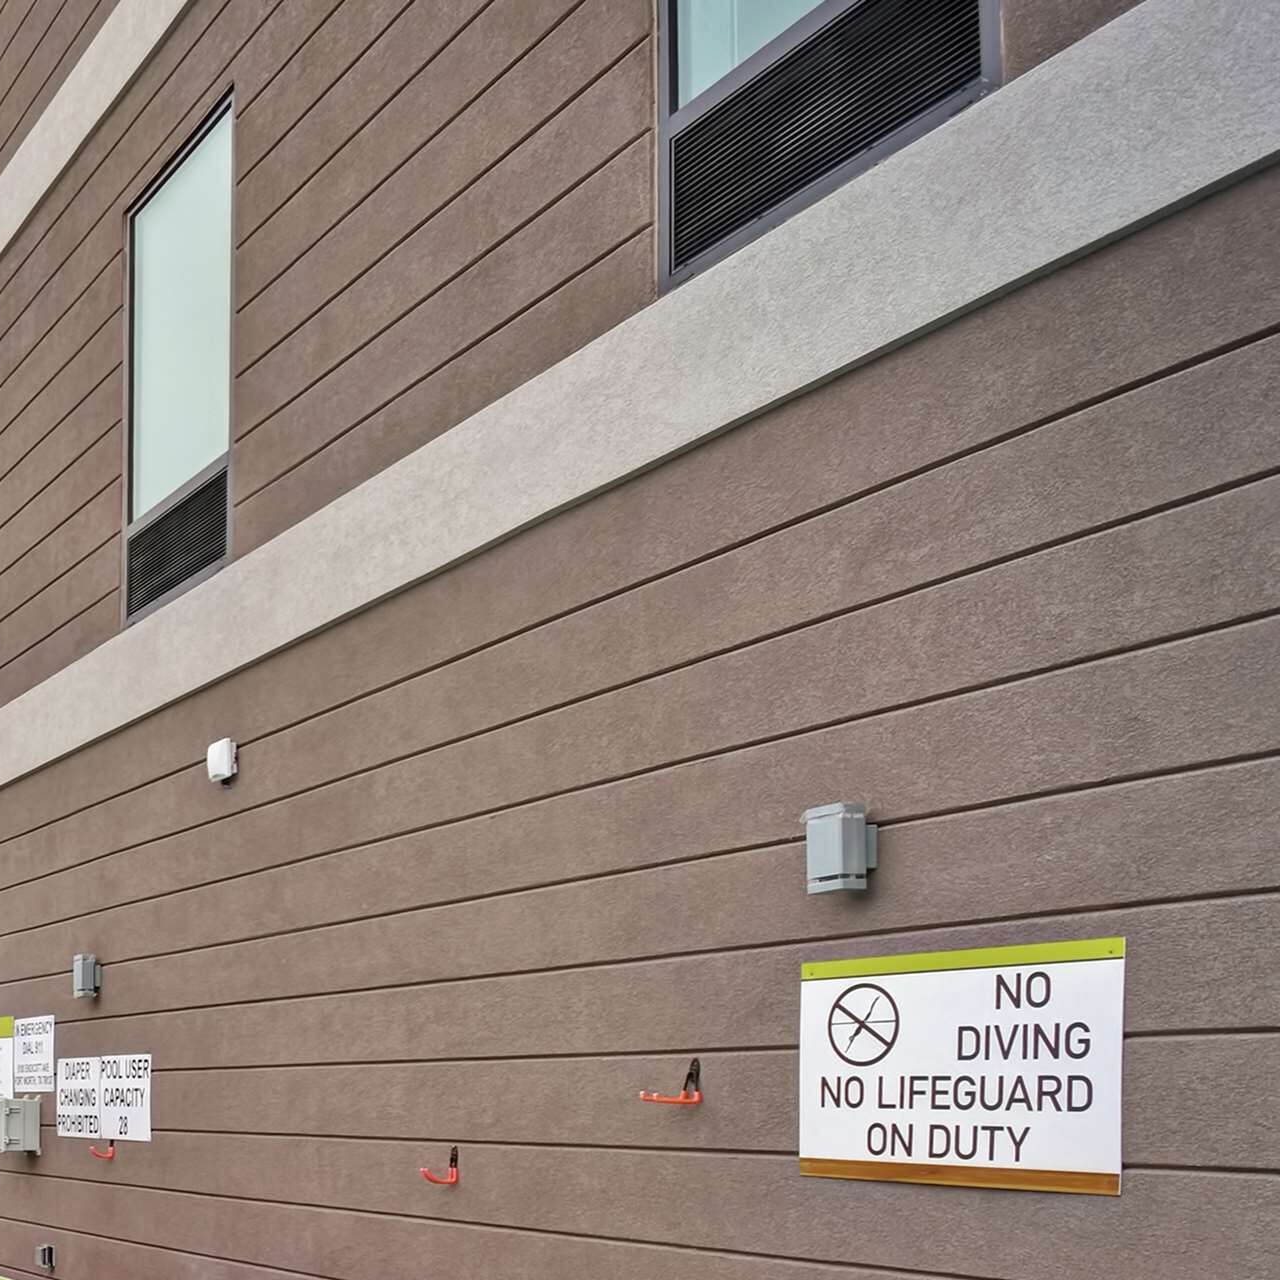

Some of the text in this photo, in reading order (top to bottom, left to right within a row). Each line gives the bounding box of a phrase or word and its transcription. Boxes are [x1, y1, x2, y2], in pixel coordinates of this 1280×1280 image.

[995, 971, 1052, 1010] NO
[957, 1021, 1091, 1061] DIVING
[65, 1062, 90, 1080] DIAPER
[101, 1059, 149, 1079] POOL USER
[59, 1088, 96, 1107] CHANGING
[103, 1088, 145, 1107] CAPACITY
[821, 1075, 1094, 1112] NO LIFEGUARD
[58, 1114, 99, 1134] PROHIBITED
[118, 1116, 128, 1135] 28
[867, 1122, 1031, 1163] ON DUTY
